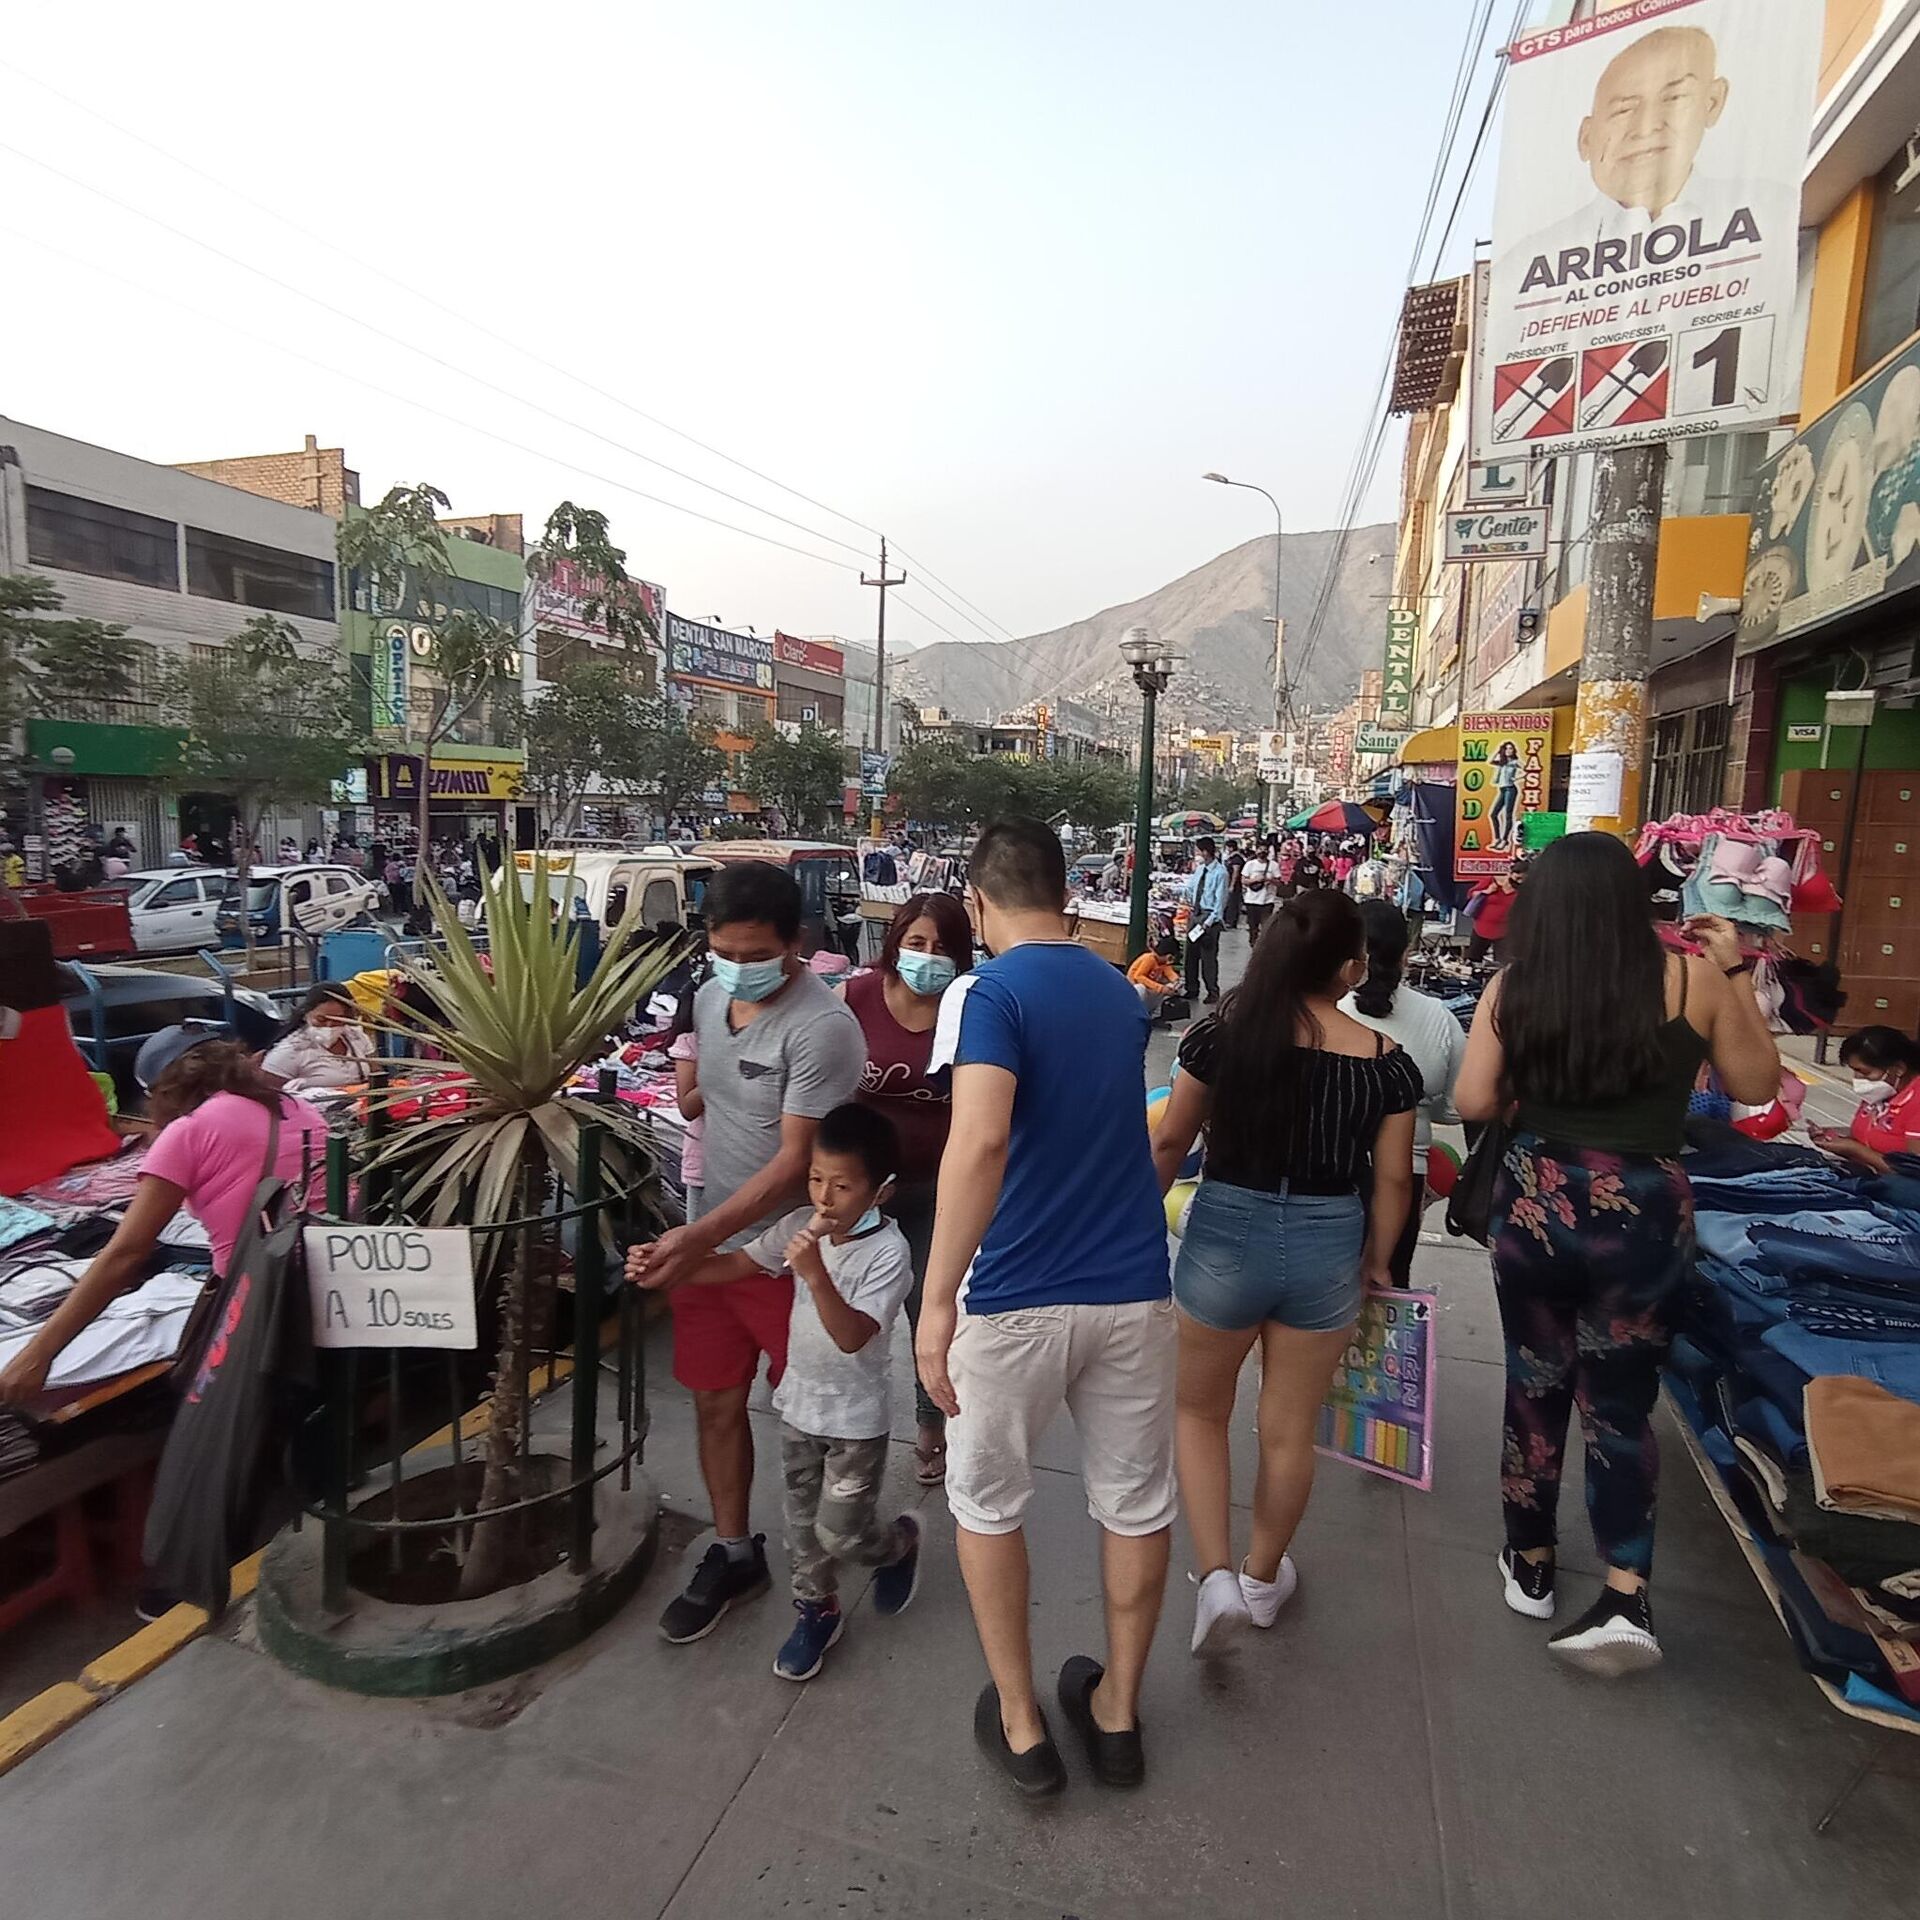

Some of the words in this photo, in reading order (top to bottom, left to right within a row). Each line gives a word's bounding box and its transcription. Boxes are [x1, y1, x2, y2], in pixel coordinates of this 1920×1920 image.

[1519, 31, 1562, 55] CTS
[1564, 20, 1594, 44] para
[1596, 7, 1633, 29] todos
[1518, 207, 1763, 294] ARRIOLA
[1565, 287, 1590, 305] AL
[1594, 263, 1702, 298] CONGRESO
[1520, 305, 1620, 342] ¡DEFIENDE
[1627, 298, 1652, 320] AL
[1658, 278, 1750, 313] PUEBLO!
[1691, 309, 1742, 328] ESCRIBE
[1742, 302, 1766, 316] ASÍ
[1505, 342, 1569, 362] PRESIDENTE
[1590, 324, 1667, 346] CONGRESISTA
[1692, 326, 1742, 407] 1
[1545, 439, 1577, 455] JOSE
[1576, 433, 1629, 453] ARRIOLA
[1628, 430, 1647, 444] AL
[1648, 420, 1720, 440] CONGRESO
[1477, 515, 1539, 540] Center
[671, 619, 711, 649] DENTAL
[713, 630, 735, 653] SAN
[735, 636, 773, 663] MARCOS
[782, 642, 805, 662] Claro
[1384, 610, 1416, 711] DENTAL
[391, 637, 407, 725] OPTICA
[802, 707, 815, 723] D
[1462, 714, 1551, 732] BIENVENIDOS
[1359, 733, 1399, 748] Santa
[1793, 728, 1817, 737] VISA
[1460, 738, 1489, 851] MODA
[326, 1231, 432, 1272] POLOS
[326, 1289, 350, 1329] A
[366, 1288, 402, 1328] 10
[402, 1310, 455, 1330] SOLES
[1383, 1328, 1399, 1350] K
[1402, 1355, 1422, 1382] R
[1365, 1375, 1379, 1396] X
[1402, 1381, 1420, 1409] Z
